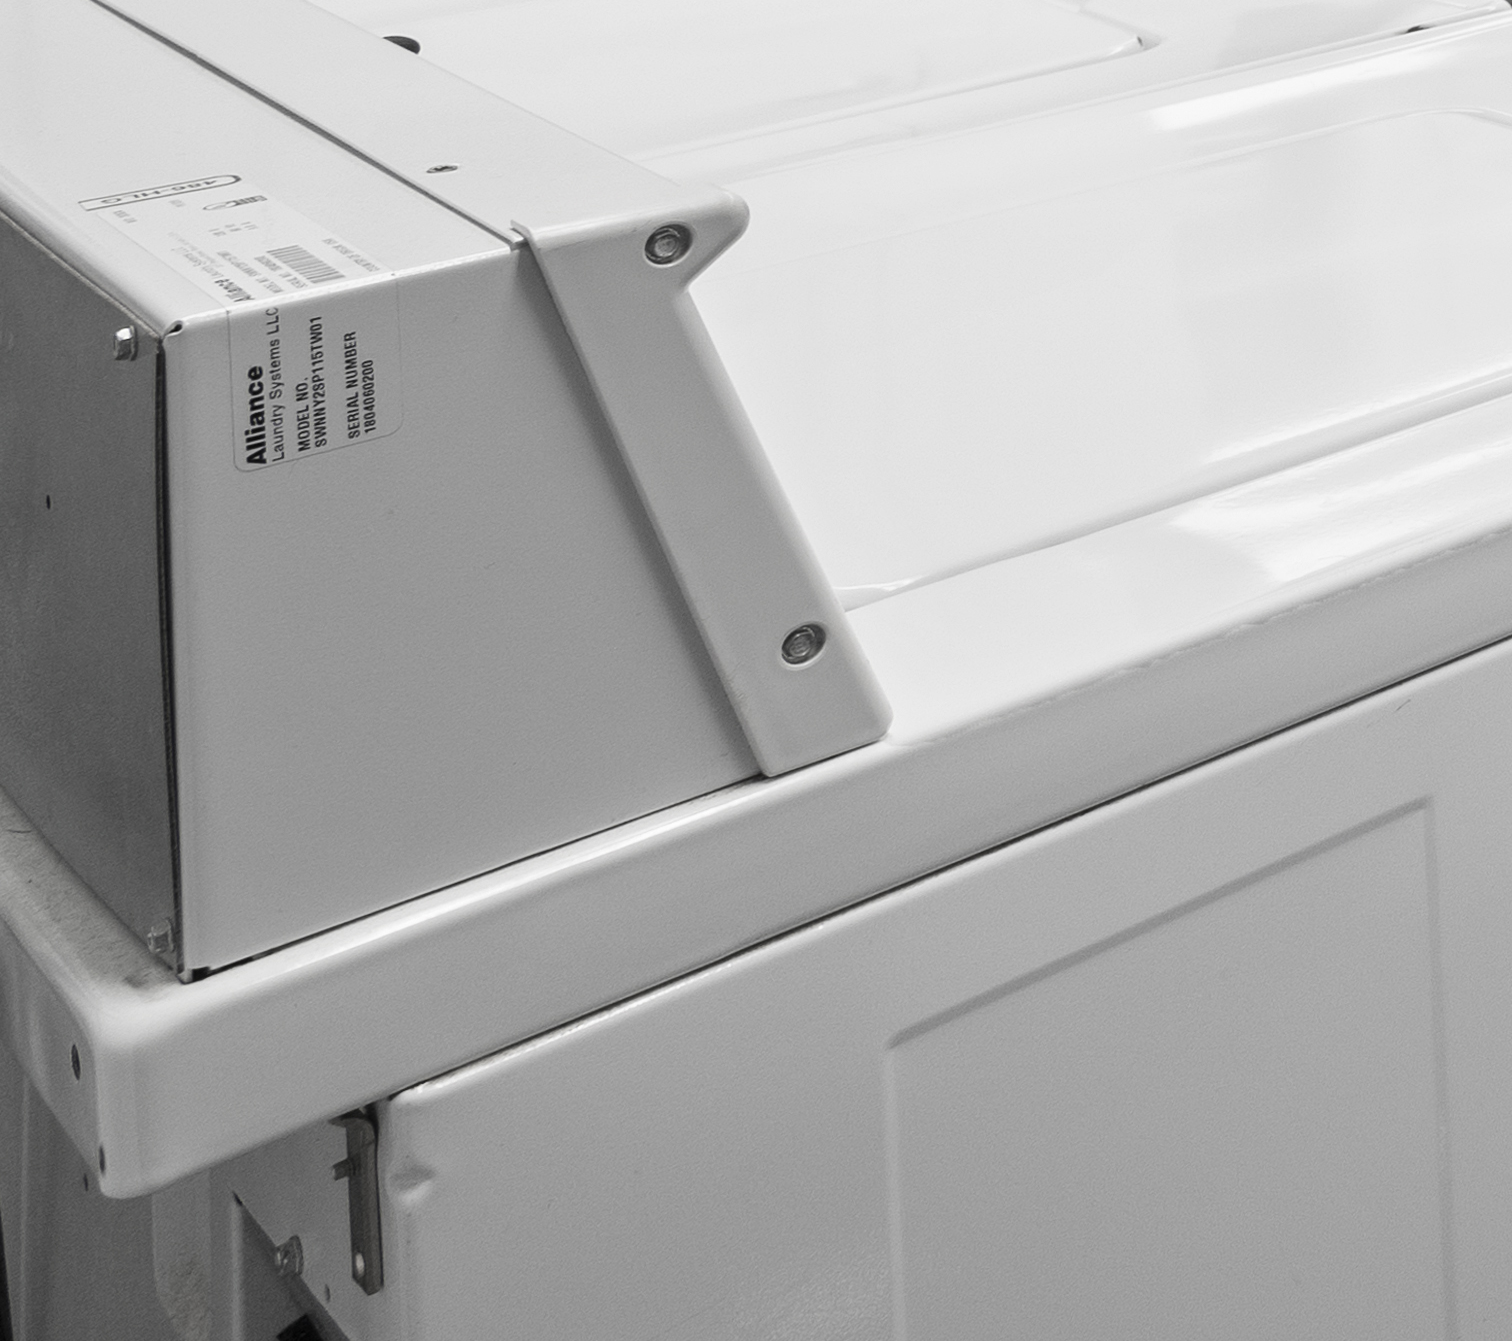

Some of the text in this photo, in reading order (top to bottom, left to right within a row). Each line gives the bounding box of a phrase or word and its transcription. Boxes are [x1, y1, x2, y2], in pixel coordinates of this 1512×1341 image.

[244, 365, 268, 466] Alliance
[265, 306, 286, 462] Laundry Systems LLC
[295, 376, 312, 453] MODEL NO.
[343, 331, 361, 439] SERIAL NUMBER
[362, 359, 377, 435] 1804060200
